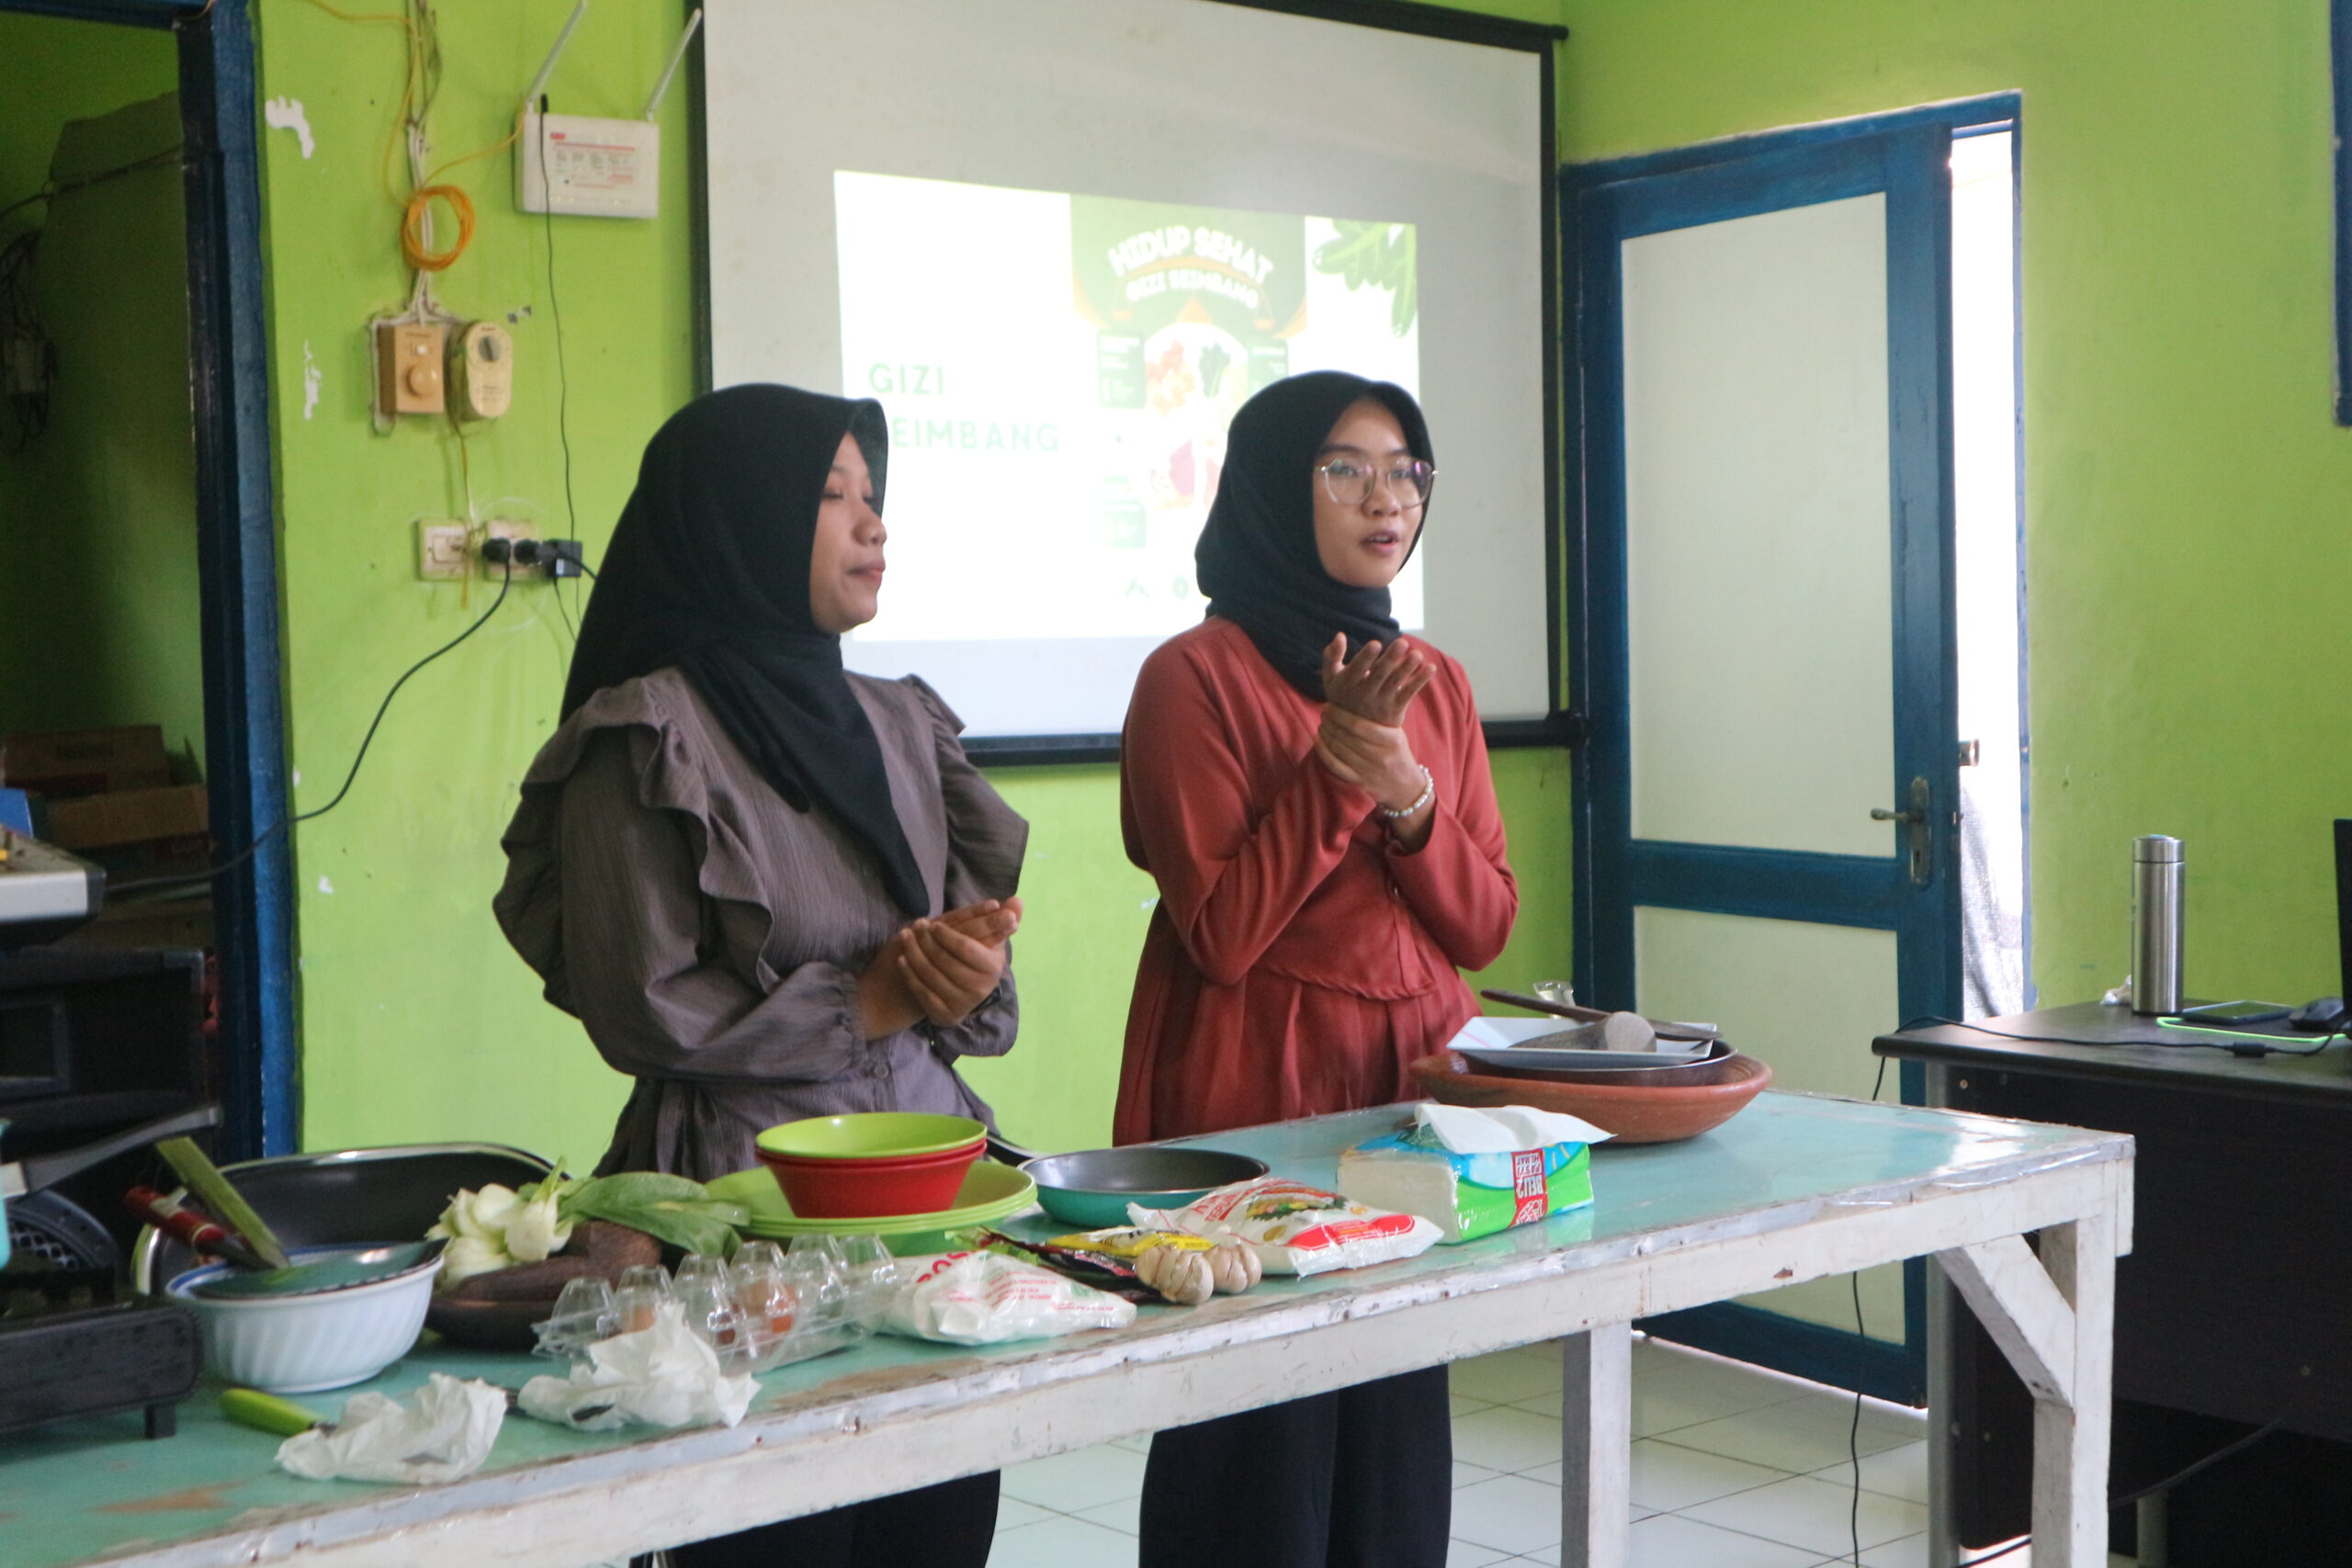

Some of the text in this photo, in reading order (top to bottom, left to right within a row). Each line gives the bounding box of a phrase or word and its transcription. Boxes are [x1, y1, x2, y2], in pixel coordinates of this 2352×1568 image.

[1108, 226, 1273, 284] HIDUP SEHAT
[1126, 272, 1165, 301] GIZI
[868, 362, 944, 395] GIZI
[890, 416, 1059, 451] EIMBANG
